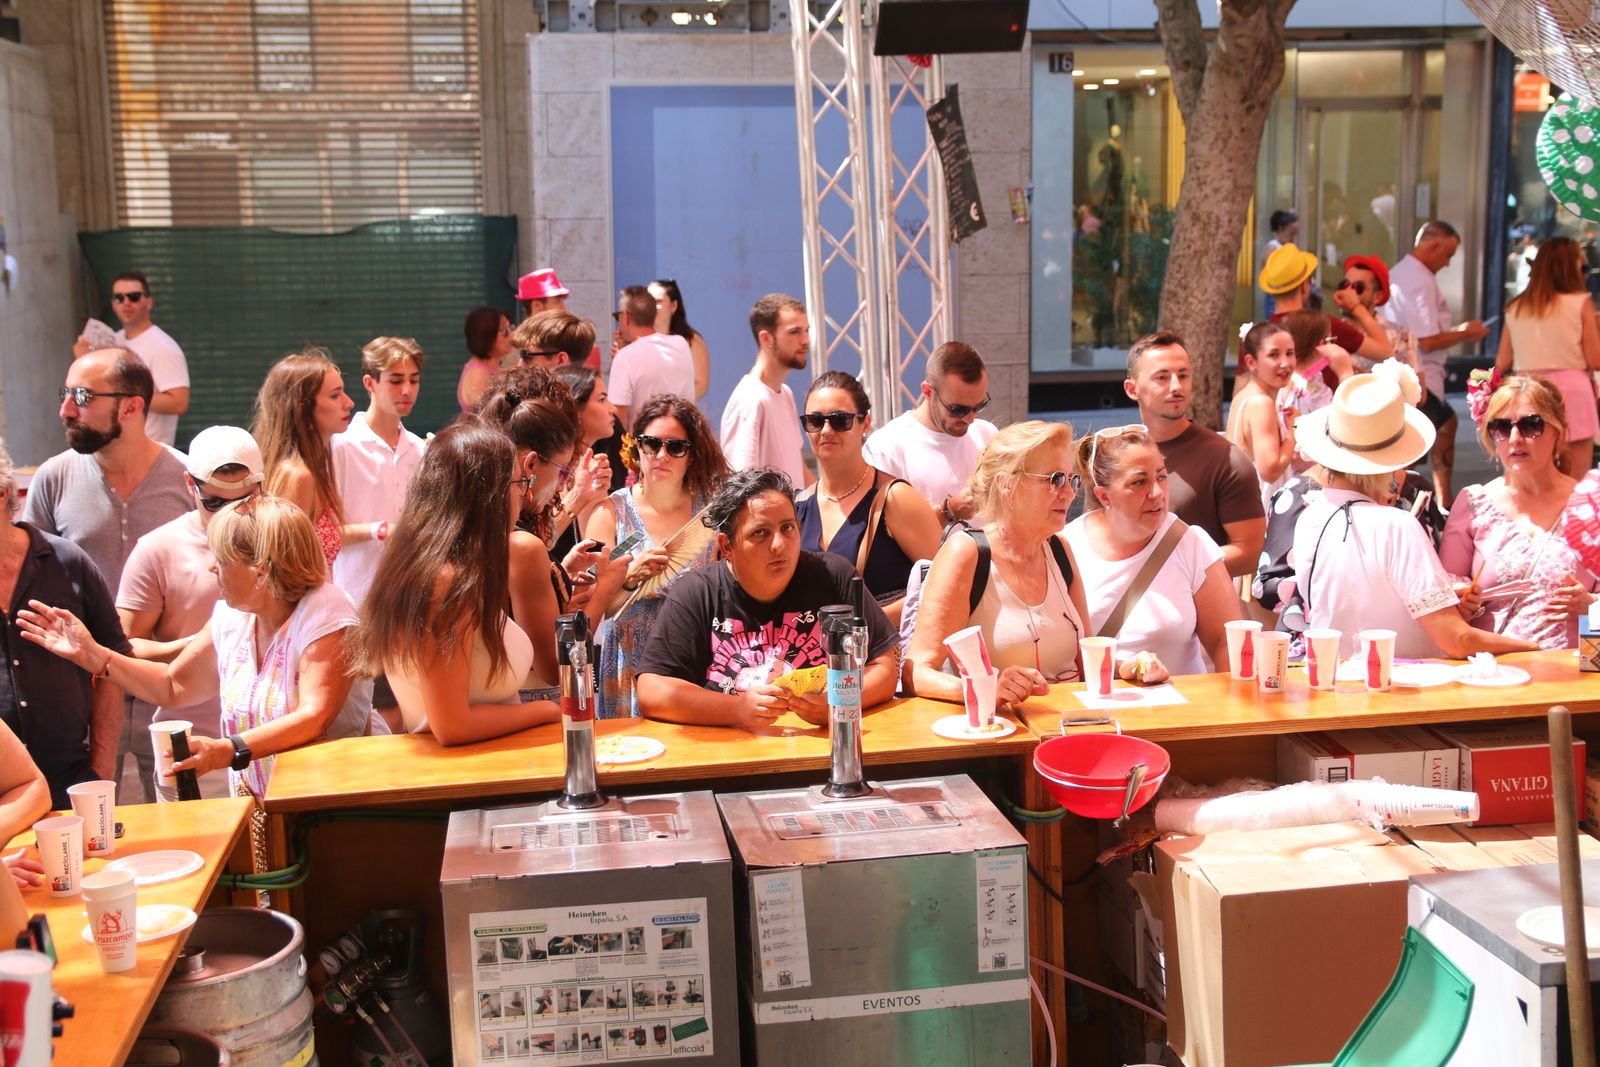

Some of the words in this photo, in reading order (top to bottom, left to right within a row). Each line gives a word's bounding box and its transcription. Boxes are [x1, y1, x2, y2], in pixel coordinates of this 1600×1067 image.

[1055, 54, 1073, 71] 16
[792, 610, 815, 624] べる
[1490, 775, 1548, 792] GITANA
[568, 910, 607, 918] Heineken
[863, 995, 921, 1010] EVENTOS
[673, 1044, 705, 1053] efficold
